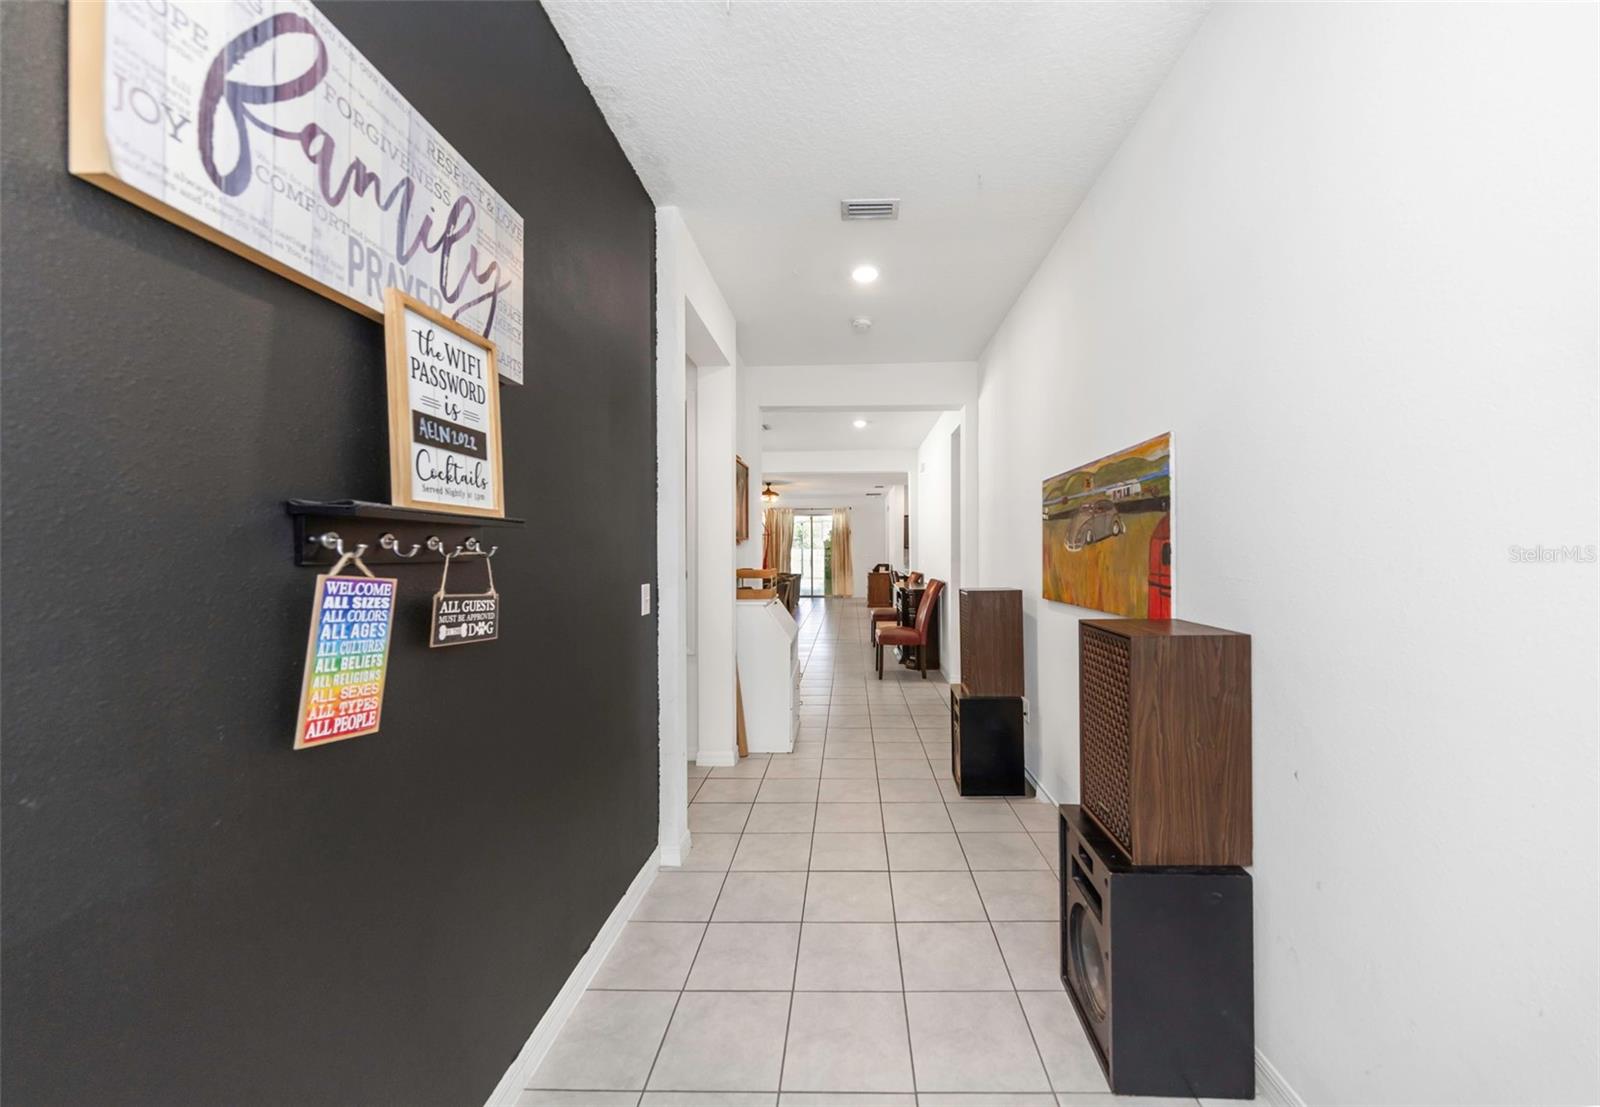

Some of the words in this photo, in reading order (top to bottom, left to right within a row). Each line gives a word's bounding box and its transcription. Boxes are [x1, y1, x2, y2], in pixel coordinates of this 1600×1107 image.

[113, 72, 192, 143] JOY
[322, 81, 451, 206] FORGIVENESS
[198, 12, 513, 338] family
[426, 140, 485, 204] RESPECT
[255, 164, 350, 234] COMFORT
[412, 328, 445, 362] the
[444, 342, 482, 380] WIFI
[411, 356, 486, 405] PASSWORD
[444, 395, 461, 421] is
[416, 448, 489, 490] Cocktails
[326, 580, 392, 597] WELCOME
[323, 596, 350, 609] ALL
[352, 596, 390, 609] SIZES
[439, 600, 461, 614] ALL
[461, 599, 496, 613] GUESTS
[322, 609, 347, 623] ALL
[347, 609, 388, 622] COLORS
[439, 614, 457, 624] MUST
[457, 613, 467, 622] BE
[466, 612, 496, 622] APPROVED
[320, 624, 349, 640] ALL
[350, 622, 386, 638] AGES
[317, 641, 338, 657] ALL
[339, 639, 385, 656] CULTURES
[315, 657, 338, 673] ALL
[340, 653, 383, 671] BELIEFS
[312, 673, 332, 689] ALL
[333, 668, 381, 687] RELIGIONS
[310, 687, 336, 704] ALL
[339, 683, 379, 700] SEXES
[307, 703, 335, 721] ALL
[339, 696, 378, 716] TYPES
[305, 720, 333, 740] ALL
[333, 711, 376, 735] PEOPLE
